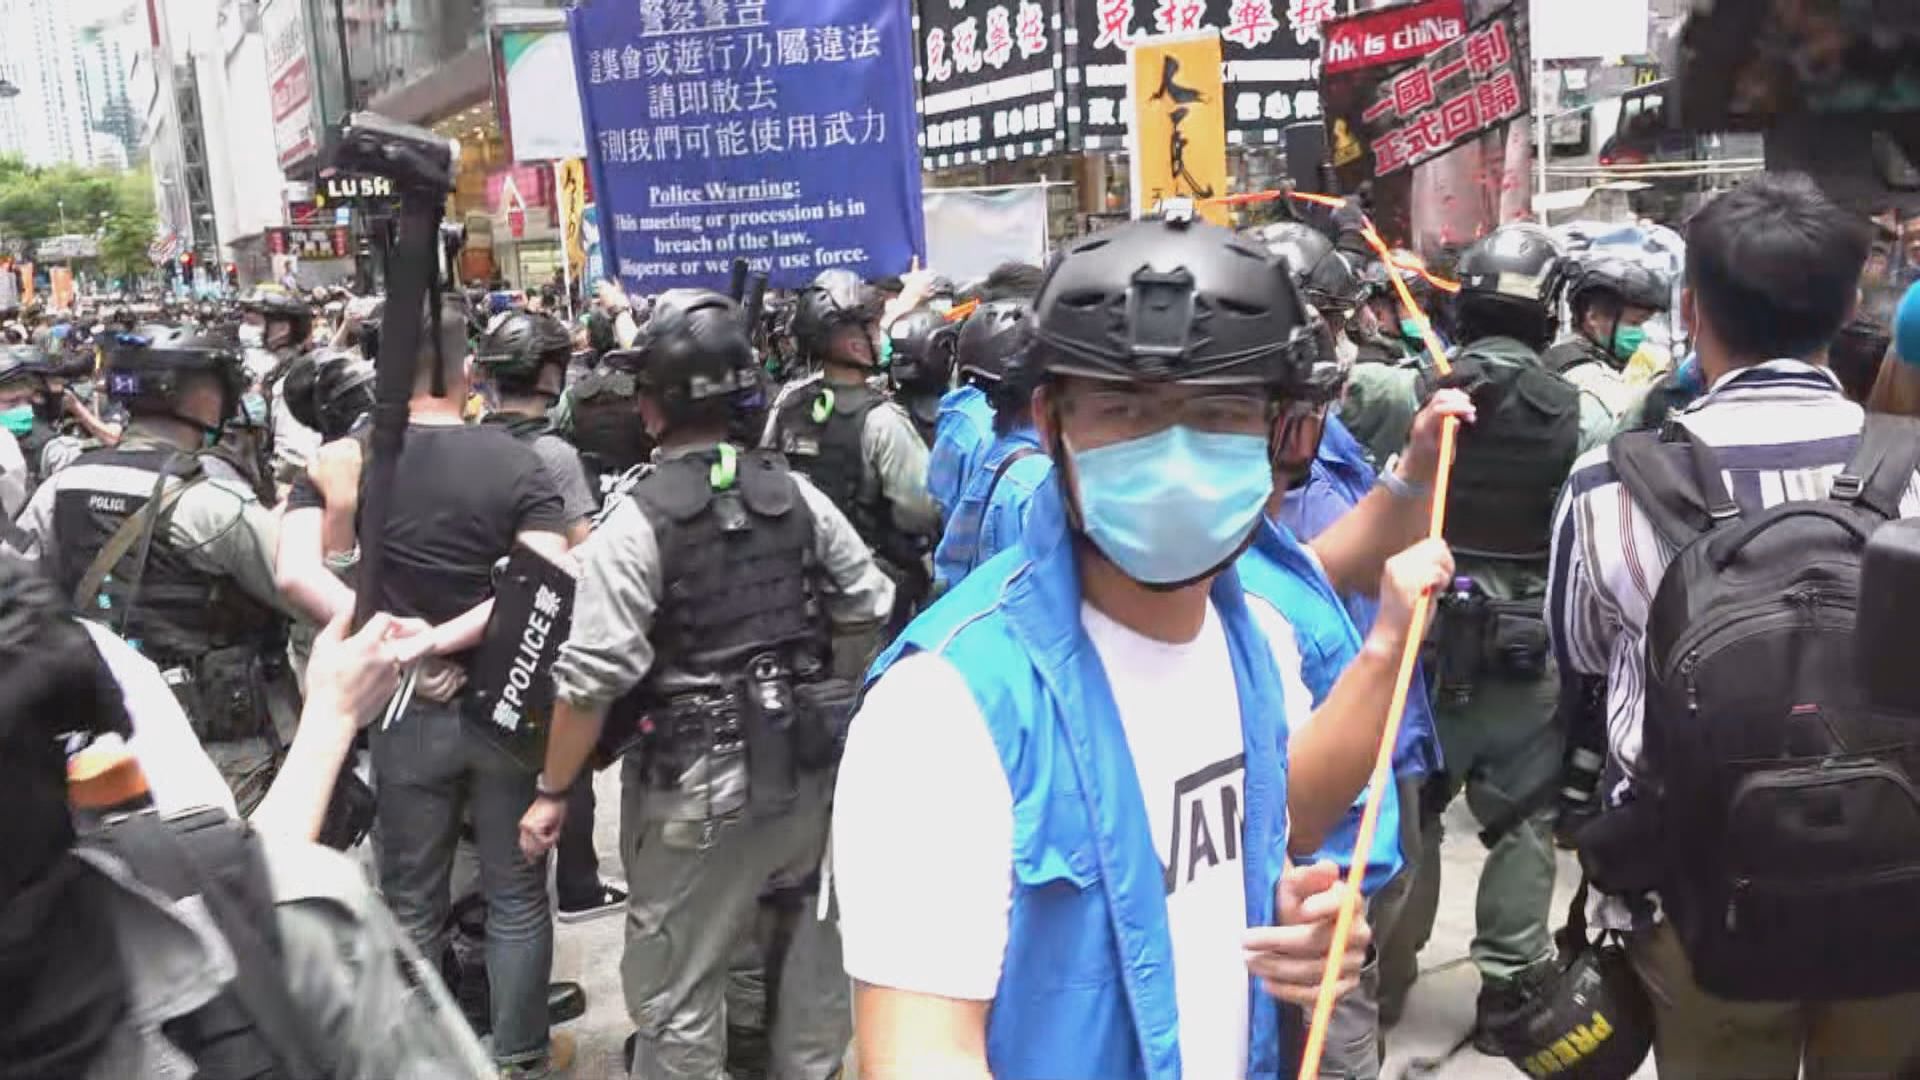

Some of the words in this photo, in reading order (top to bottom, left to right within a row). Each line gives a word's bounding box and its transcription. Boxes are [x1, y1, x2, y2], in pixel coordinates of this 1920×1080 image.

[1362, 20, 1510, 123] 一國一制
[648, 76, 778, 120] 請即散去
[1150, 54, 1214, 213] 人民
[1371, 68, 1520, 177] 正式回歸
[649, 183, 702, 204] Police
[704, 177, 801, 202] Warning:
[640, 211, 704, 233] meeting
[706, 214, 724, 228] or
[729, 204, 825, 230] procession
[828, 200, 844, 219] is
[848, 198, 865, 216] in
[653, 234, 713, 254] breach
[716, 231, 736, 250] of
[738, 231, 769, 250] the
[772, 229, 812, 248] law.
[681, 260, 701, 275] or
[705, 258, 729, 274] we
[779, 255, 811, 269] use
[815, 246, 870, 267] force.
